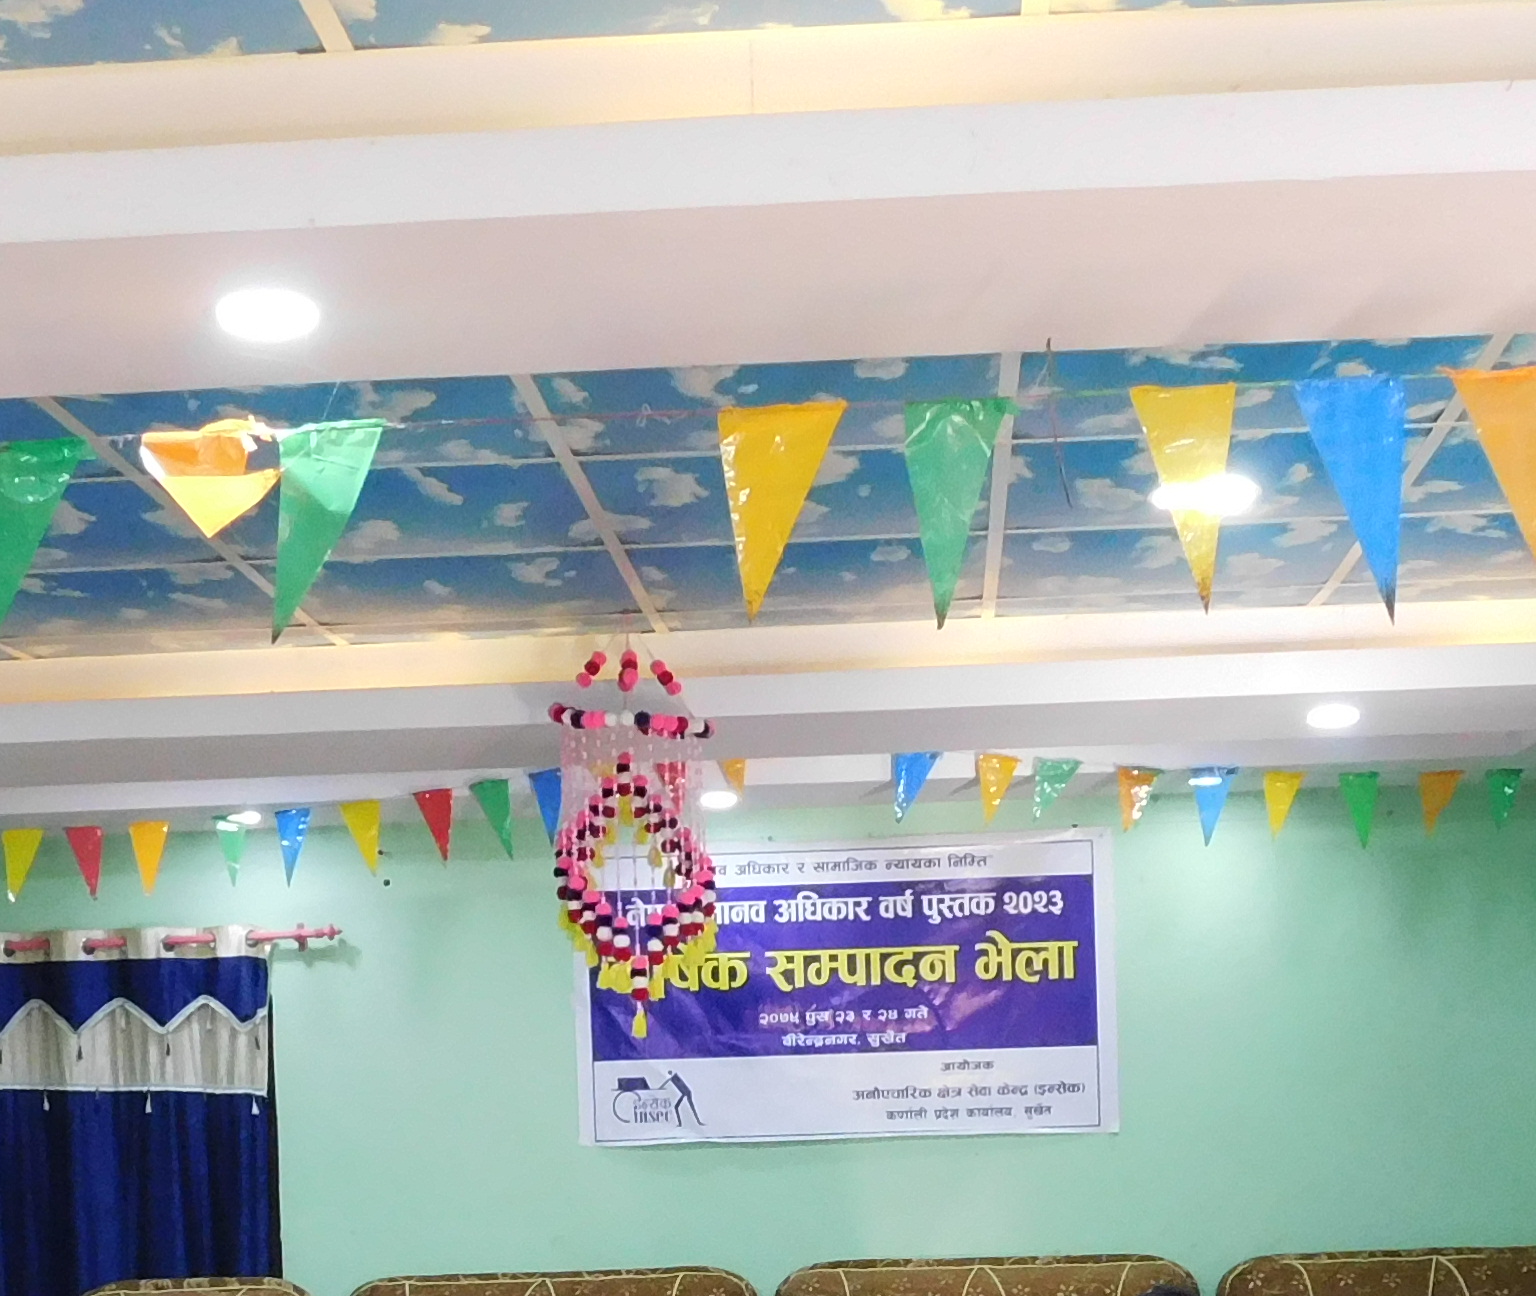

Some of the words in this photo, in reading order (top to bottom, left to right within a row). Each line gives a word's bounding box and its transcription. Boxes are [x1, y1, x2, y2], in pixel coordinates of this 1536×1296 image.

[734, 859, 790, 876] अधिकार
[796, 861, 806, 875] र
[813, 857, 879, 872] सामाजिक
[884, 857, 942, 871] न्यायका
[773, 891, 873, 924] अधिकार
[878, 889, 915, 919] वर्ष
[920, 892, 997, 925] पुस्तक
[1002, 889, 1064, 916] २०२३
[764, 945, 960, 992] सम्पादन
[974, 929, 1079, 983] भेला
[940, 1059, 995, 1072] आयोजक
